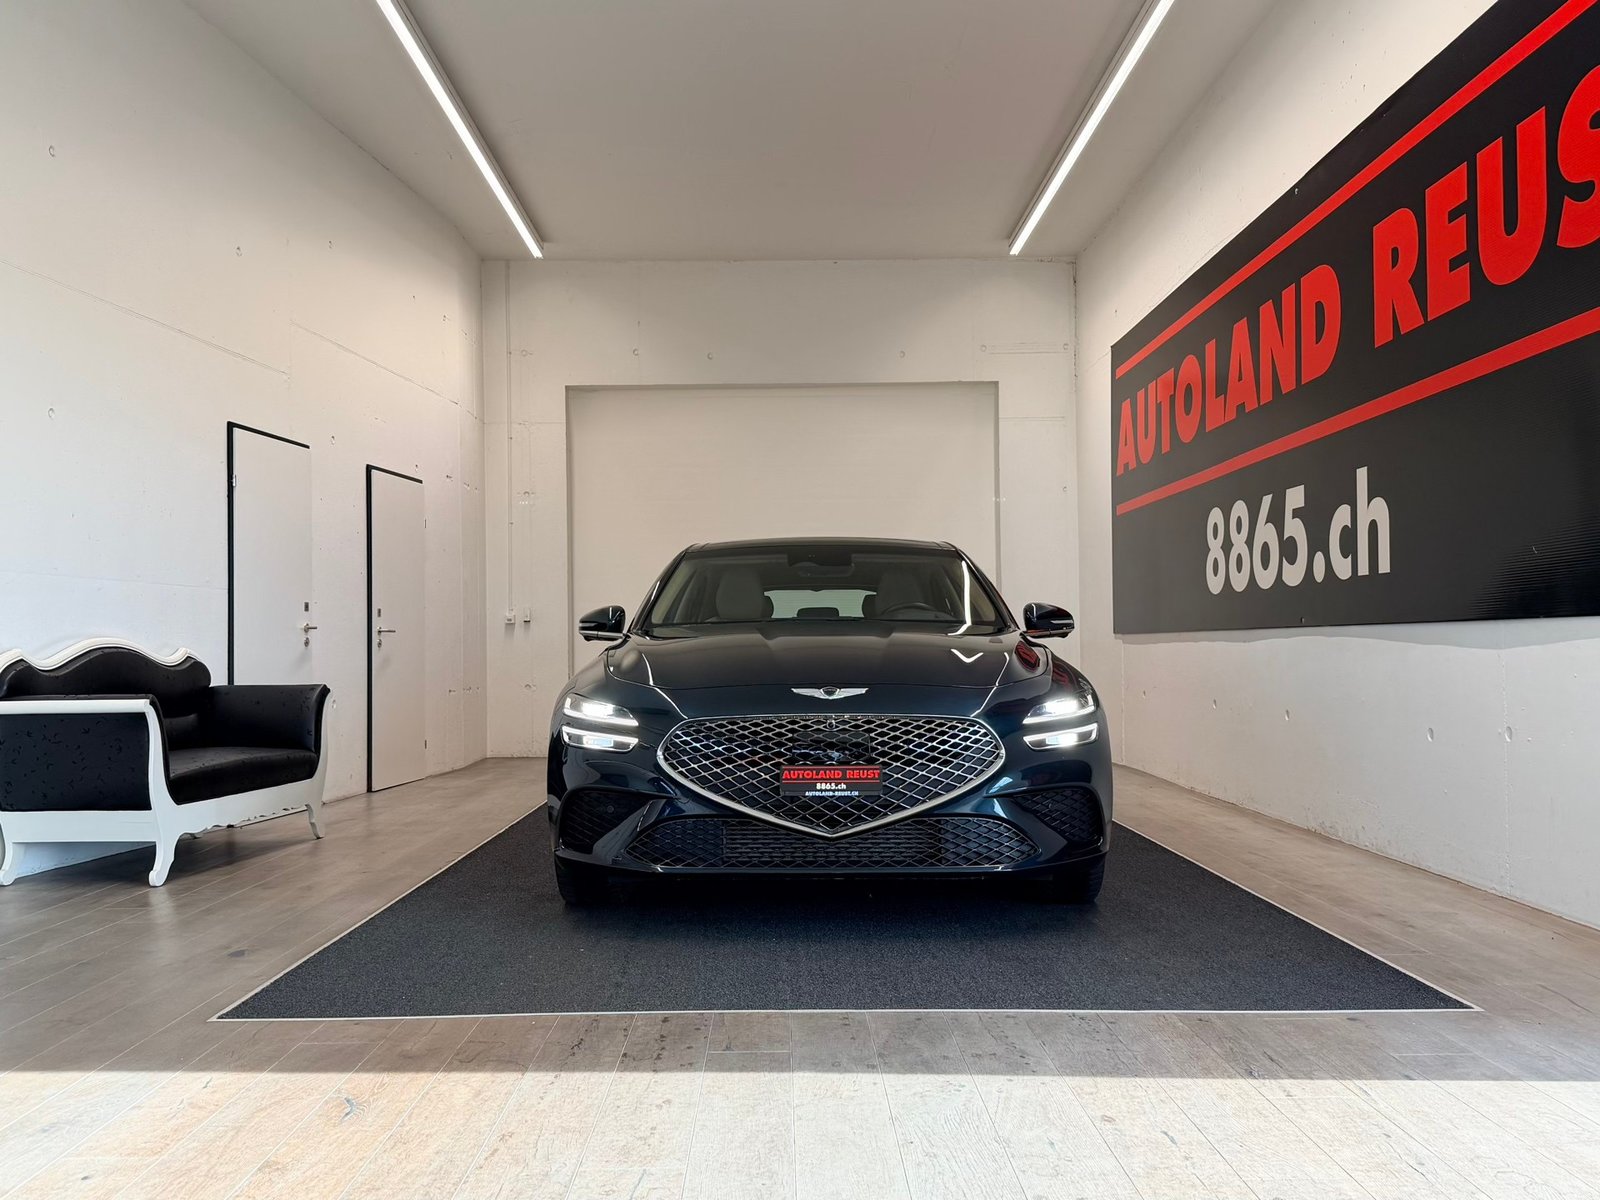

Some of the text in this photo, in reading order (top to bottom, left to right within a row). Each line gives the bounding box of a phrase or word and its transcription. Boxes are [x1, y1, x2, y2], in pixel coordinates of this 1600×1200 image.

[1116, 264, 1342, 477] AUTOLAND
[1205, 465, 1391, 595] 8865.ch
[782, 769, 880, 779] AUTOLAND REUST
[816, 782, 847, 790] 8865.ch
